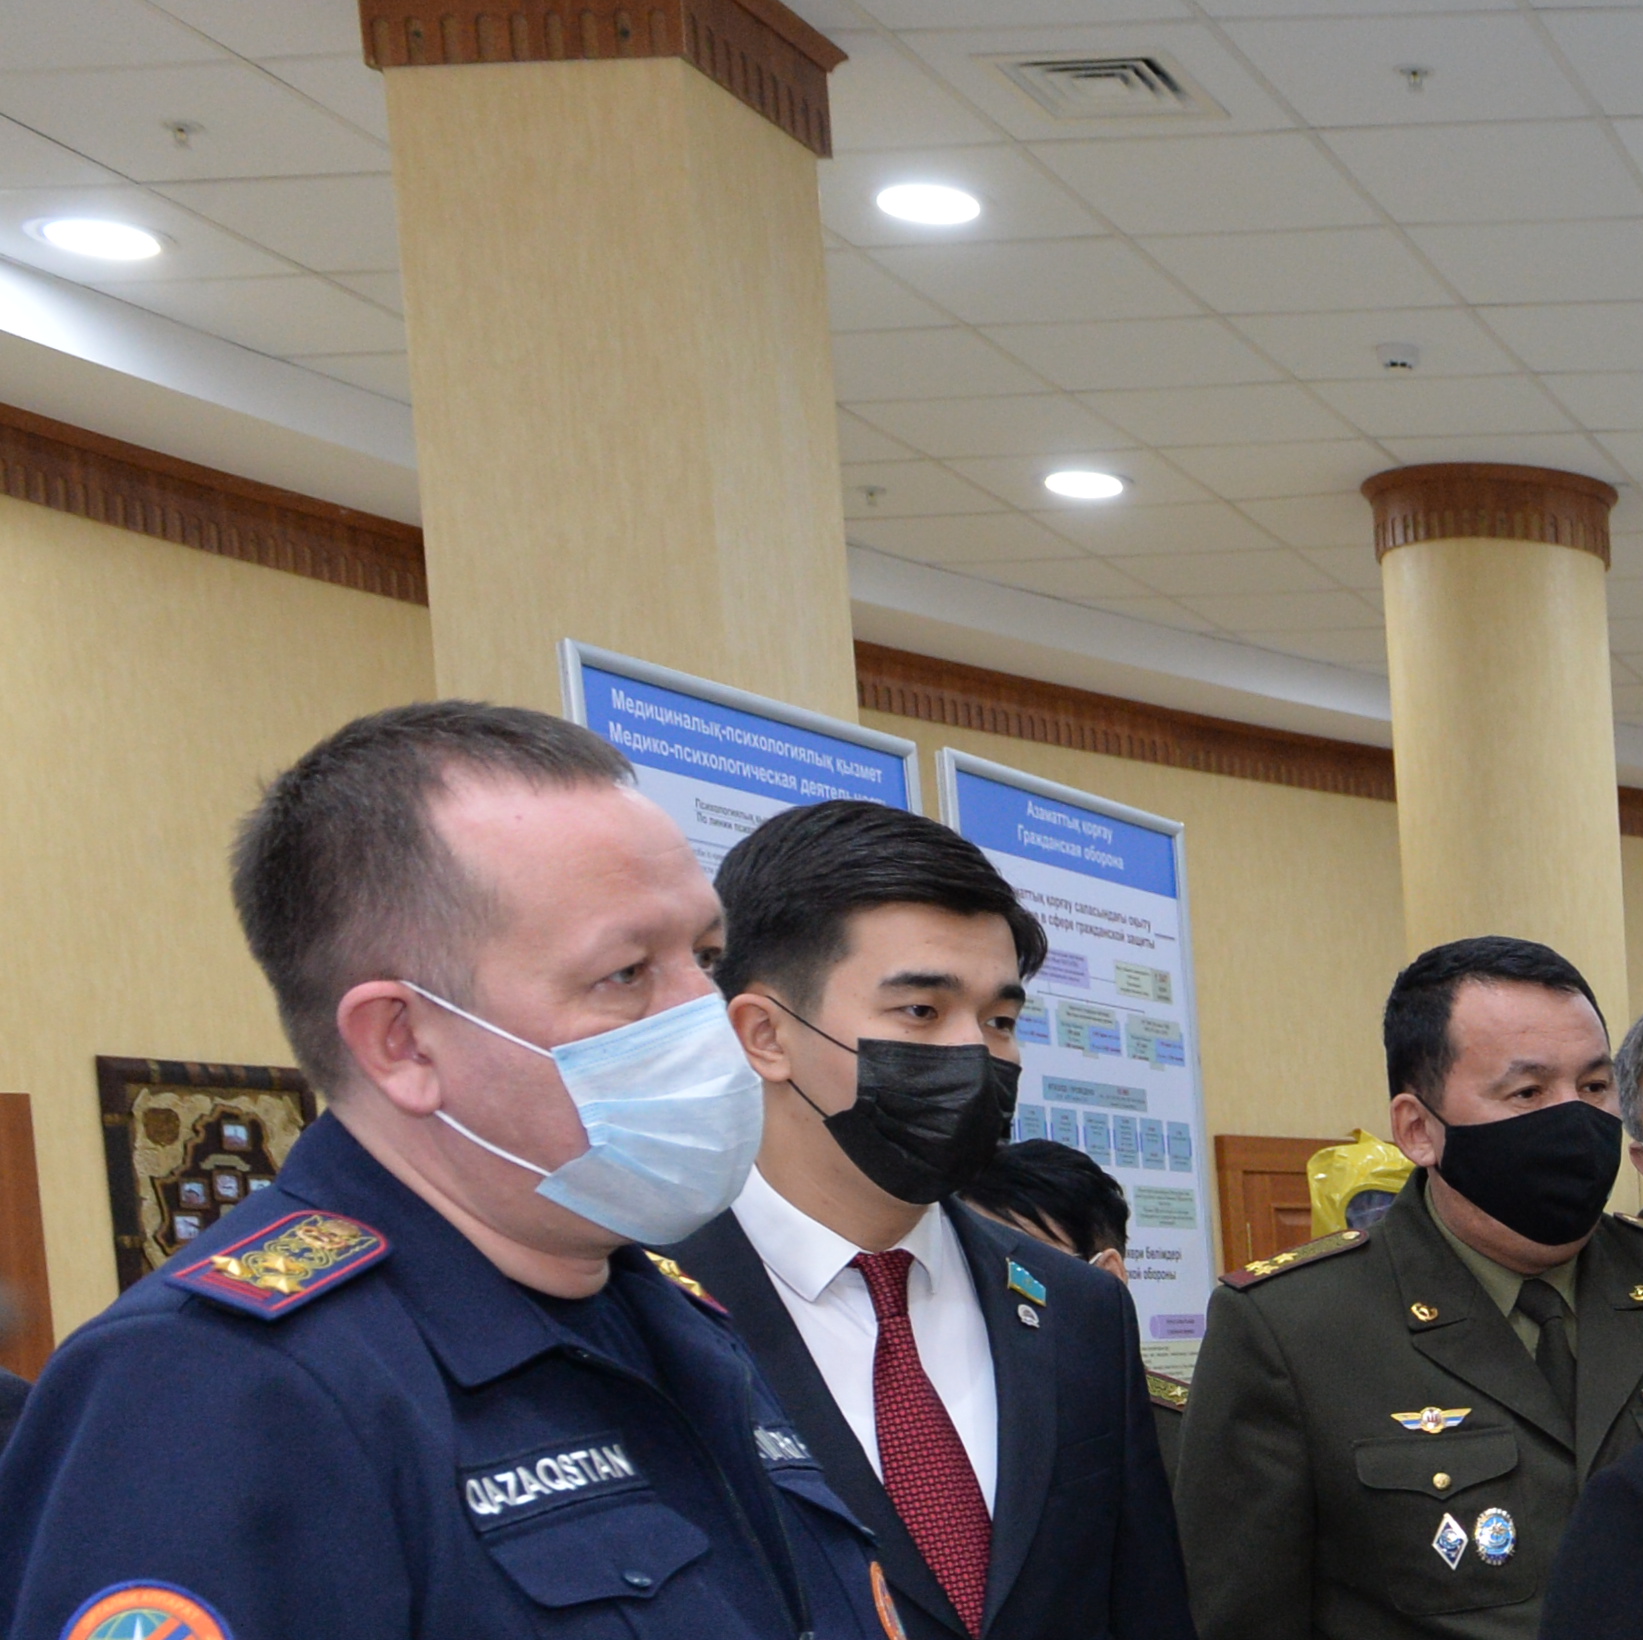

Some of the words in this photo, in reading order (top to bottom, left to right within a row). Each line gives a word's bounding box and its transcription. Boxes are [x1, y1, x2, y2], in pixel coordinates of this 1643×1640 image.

[608, 721, 797, 791] Медико-психологическая
[611, 688, 834, 773] Медициналық-психологиялық
[836, 757, 883, 784] қызмет
[1017, 824, 1081, 858] Гражданская
[1084, 844, 1124, 871] оборона
[465, 1444, 636, 1516] QAZAQSTAN
